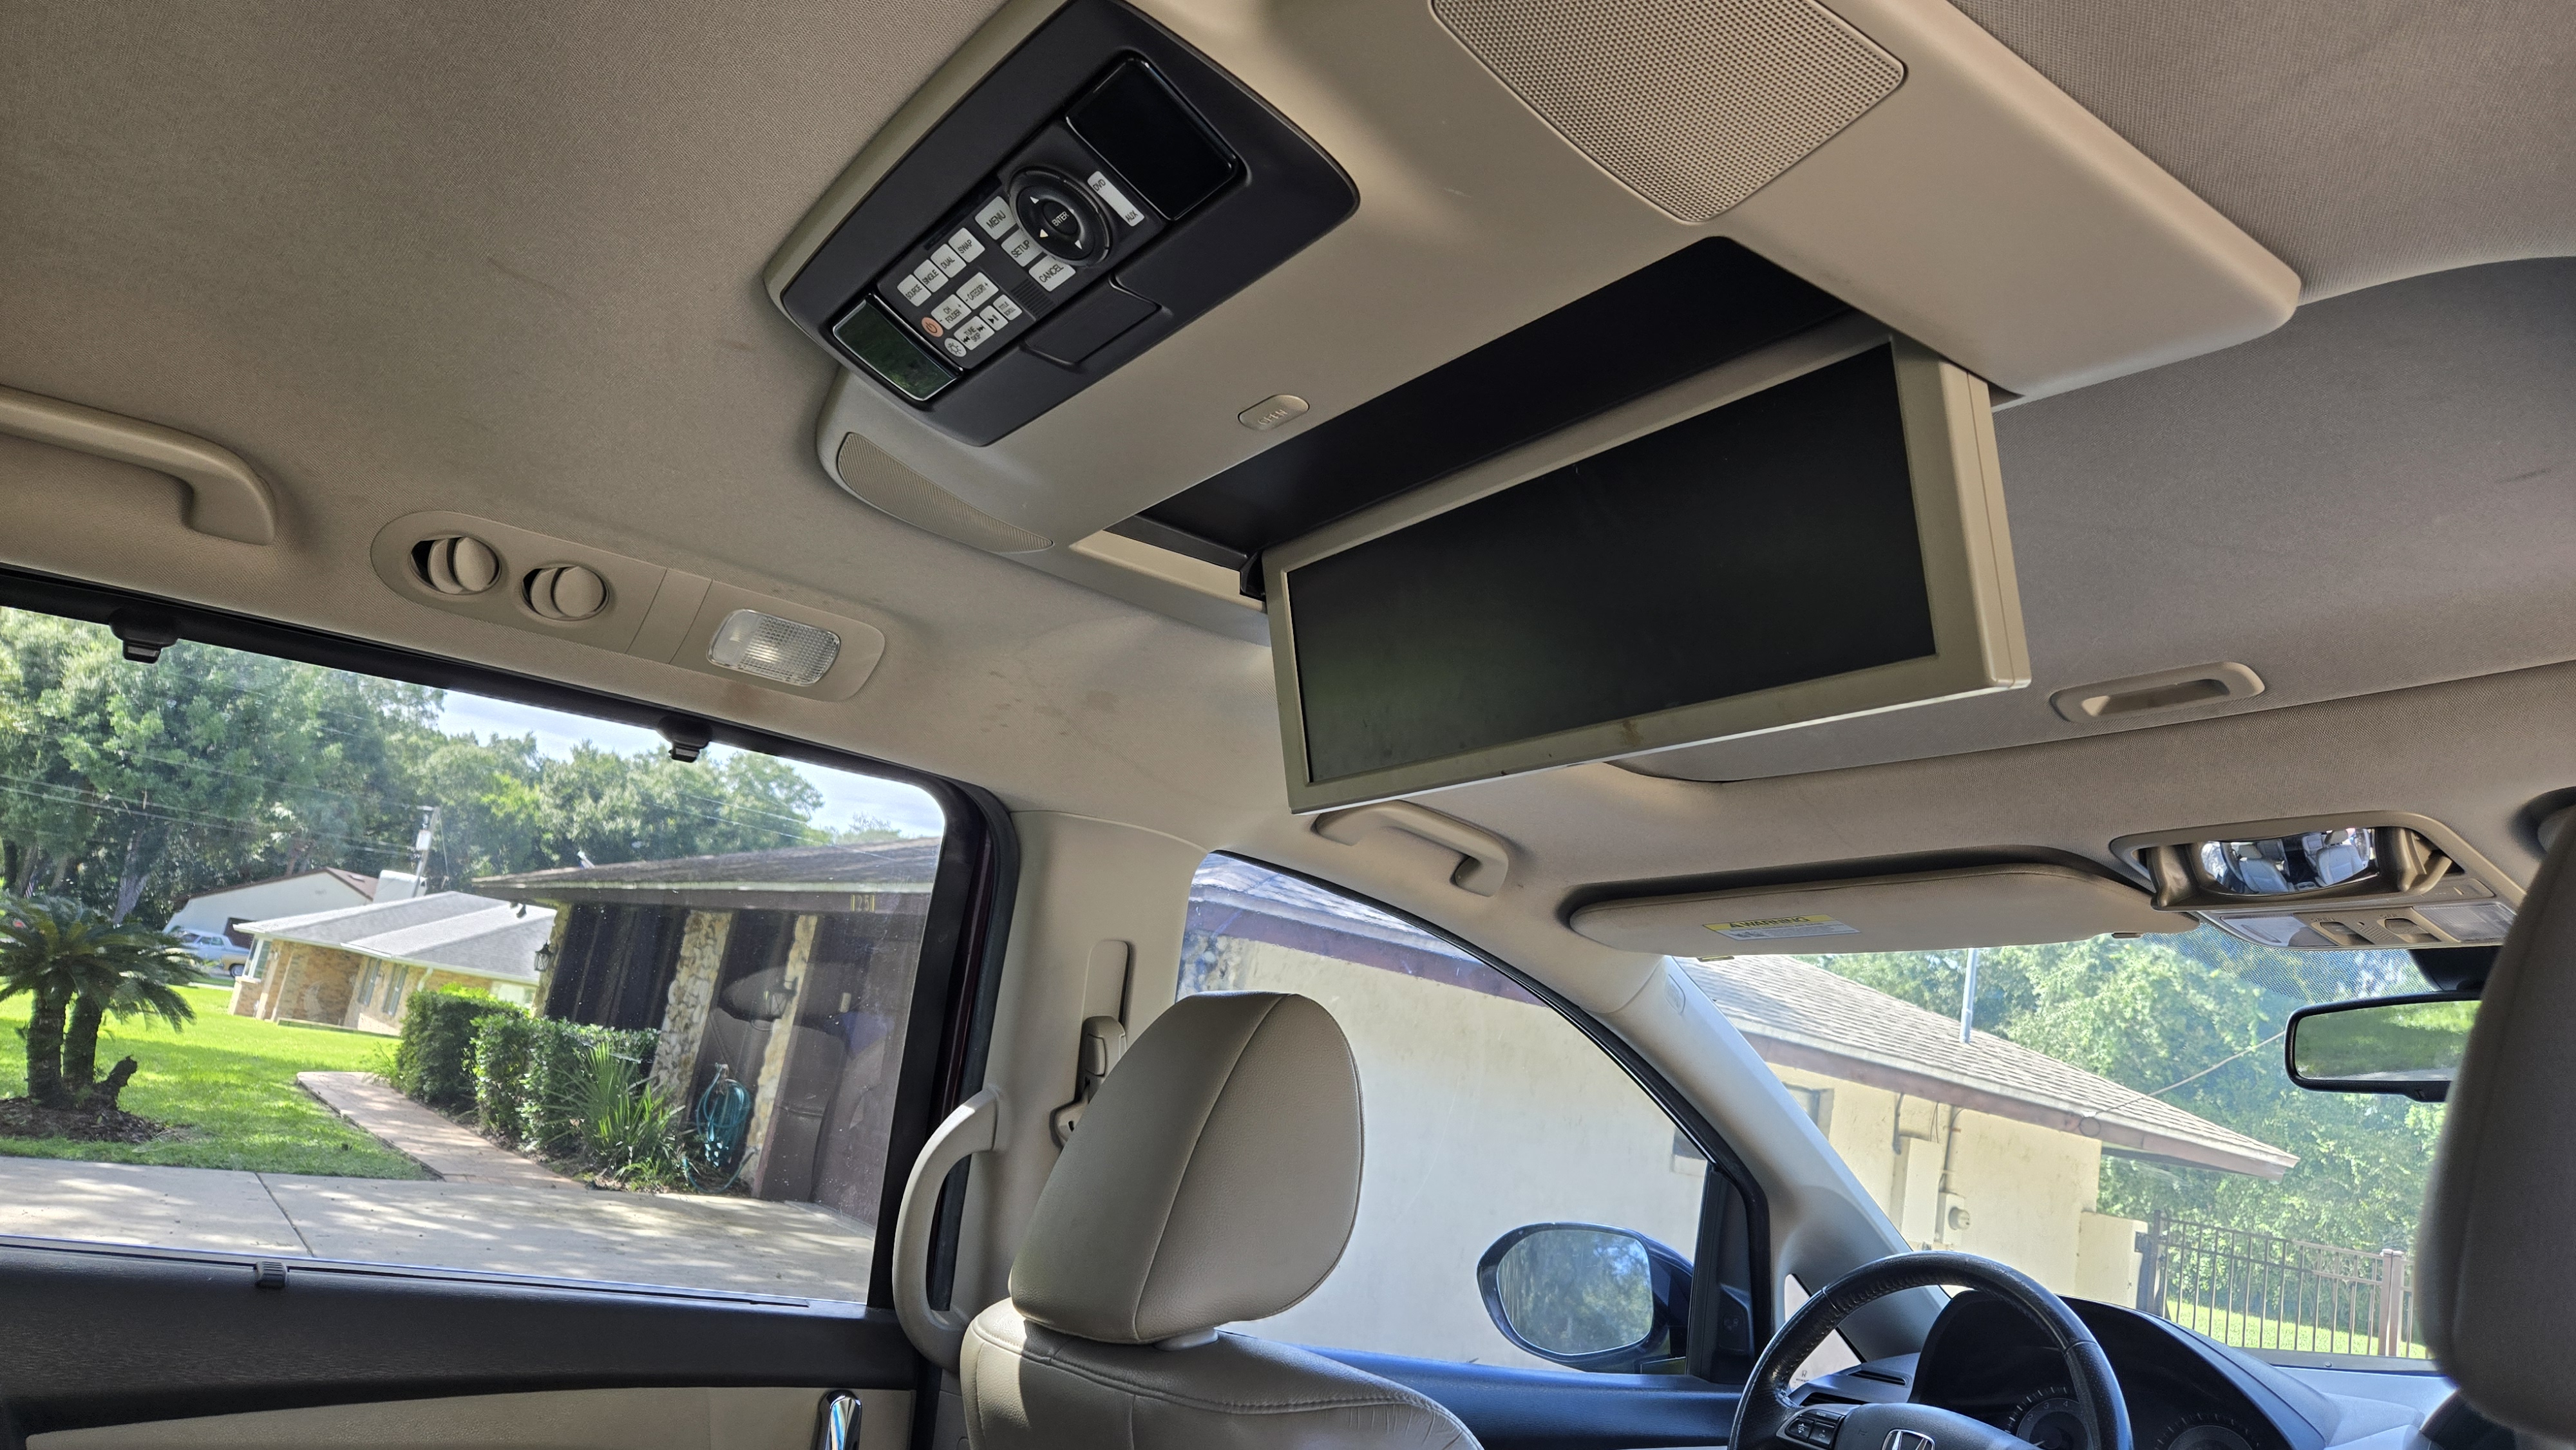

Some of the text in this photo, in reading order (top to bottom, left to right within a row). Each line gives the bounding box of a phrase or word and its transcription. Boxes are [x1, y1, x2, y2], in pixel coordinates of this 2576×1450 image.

[1093, 179, 1106, 191] DVD
[986, 210, 1006, 229] MENU
[1052, 211, 1069, 226] ENTER
[1125, 210, 1138, 222] AUX
[958, 239, 972, 254] SWAP
[1011, 240, 1030, 258] SETUP
[940, 256, 955, 269] DUAL
[922, 269, 939, 285] SINGLE
[1039, 264, 1064, 283] CANCEL
[905, 284, 922, 299] SOURCE
[945, 309, 962, 323] FOLDER
[1741, 916, 1810, 928] WARNING
